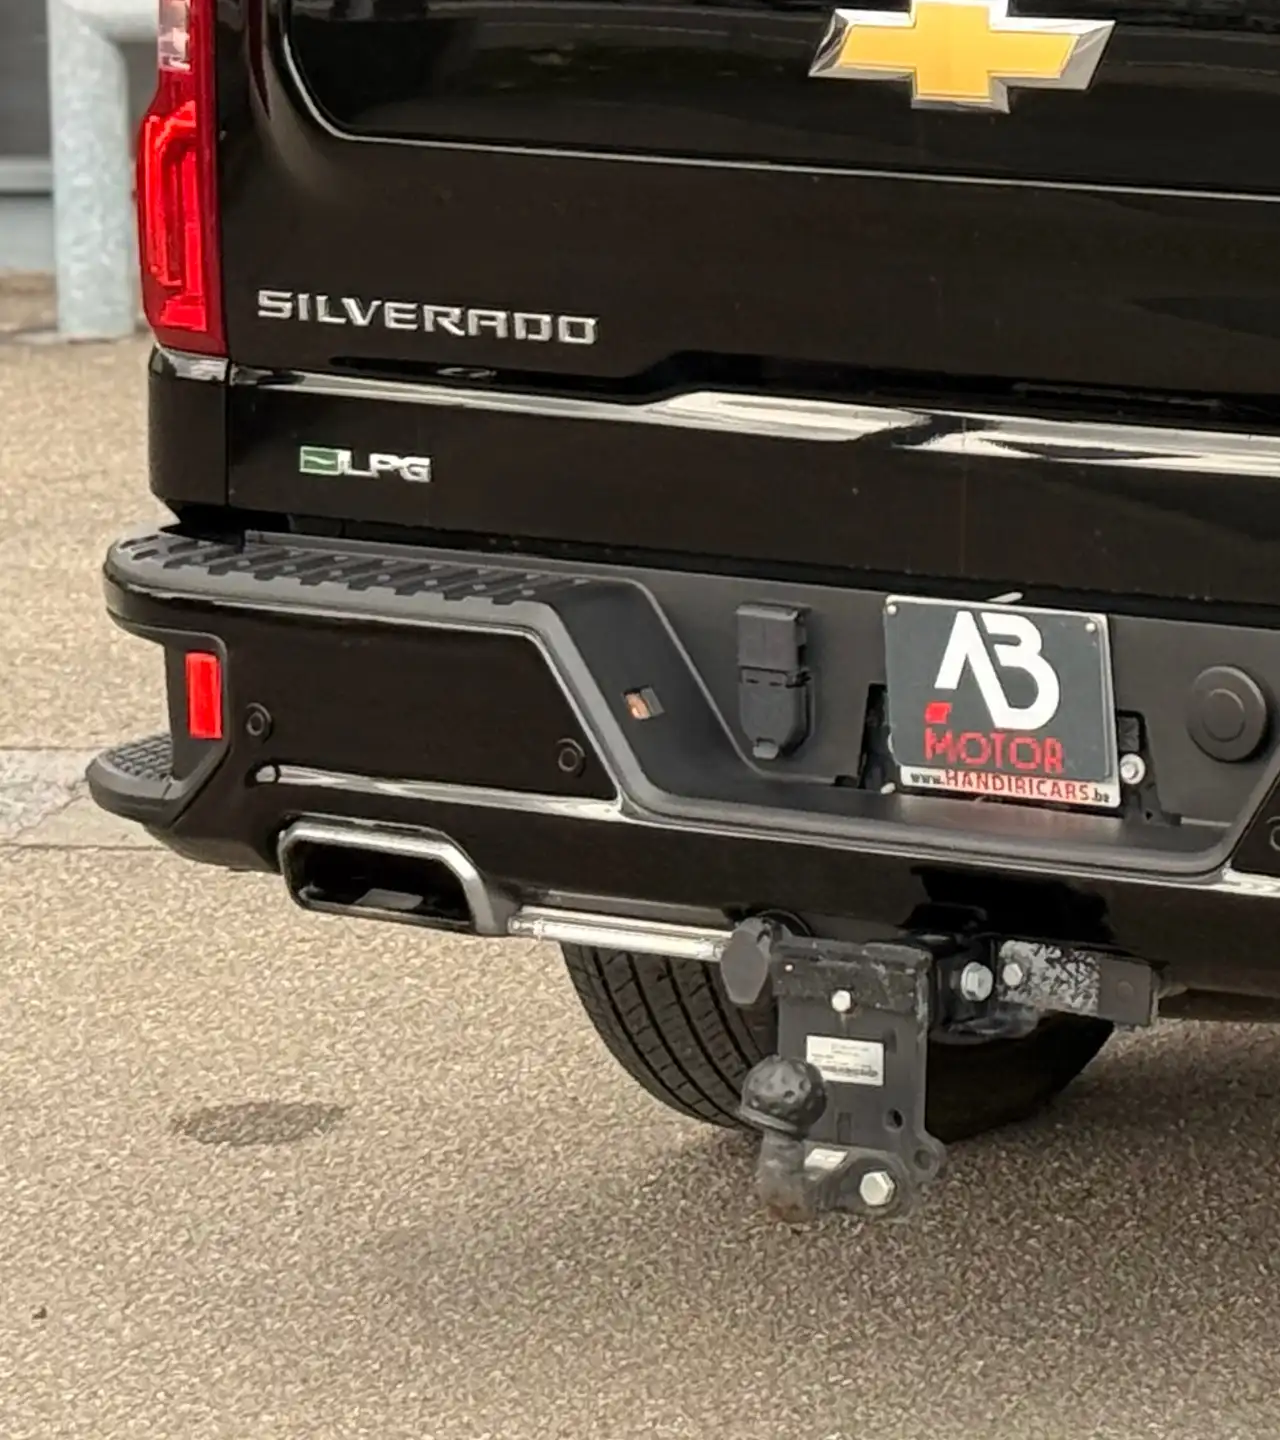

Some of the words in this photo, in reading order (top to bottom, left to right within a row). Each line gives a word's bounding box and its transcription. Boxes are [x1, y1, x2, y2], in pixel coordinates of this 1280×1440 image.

[257, 288, 600, 346] SILVERADO
[933, 610, 1060, 730] AB
[923, 727, 1065, 774] MOTOR
